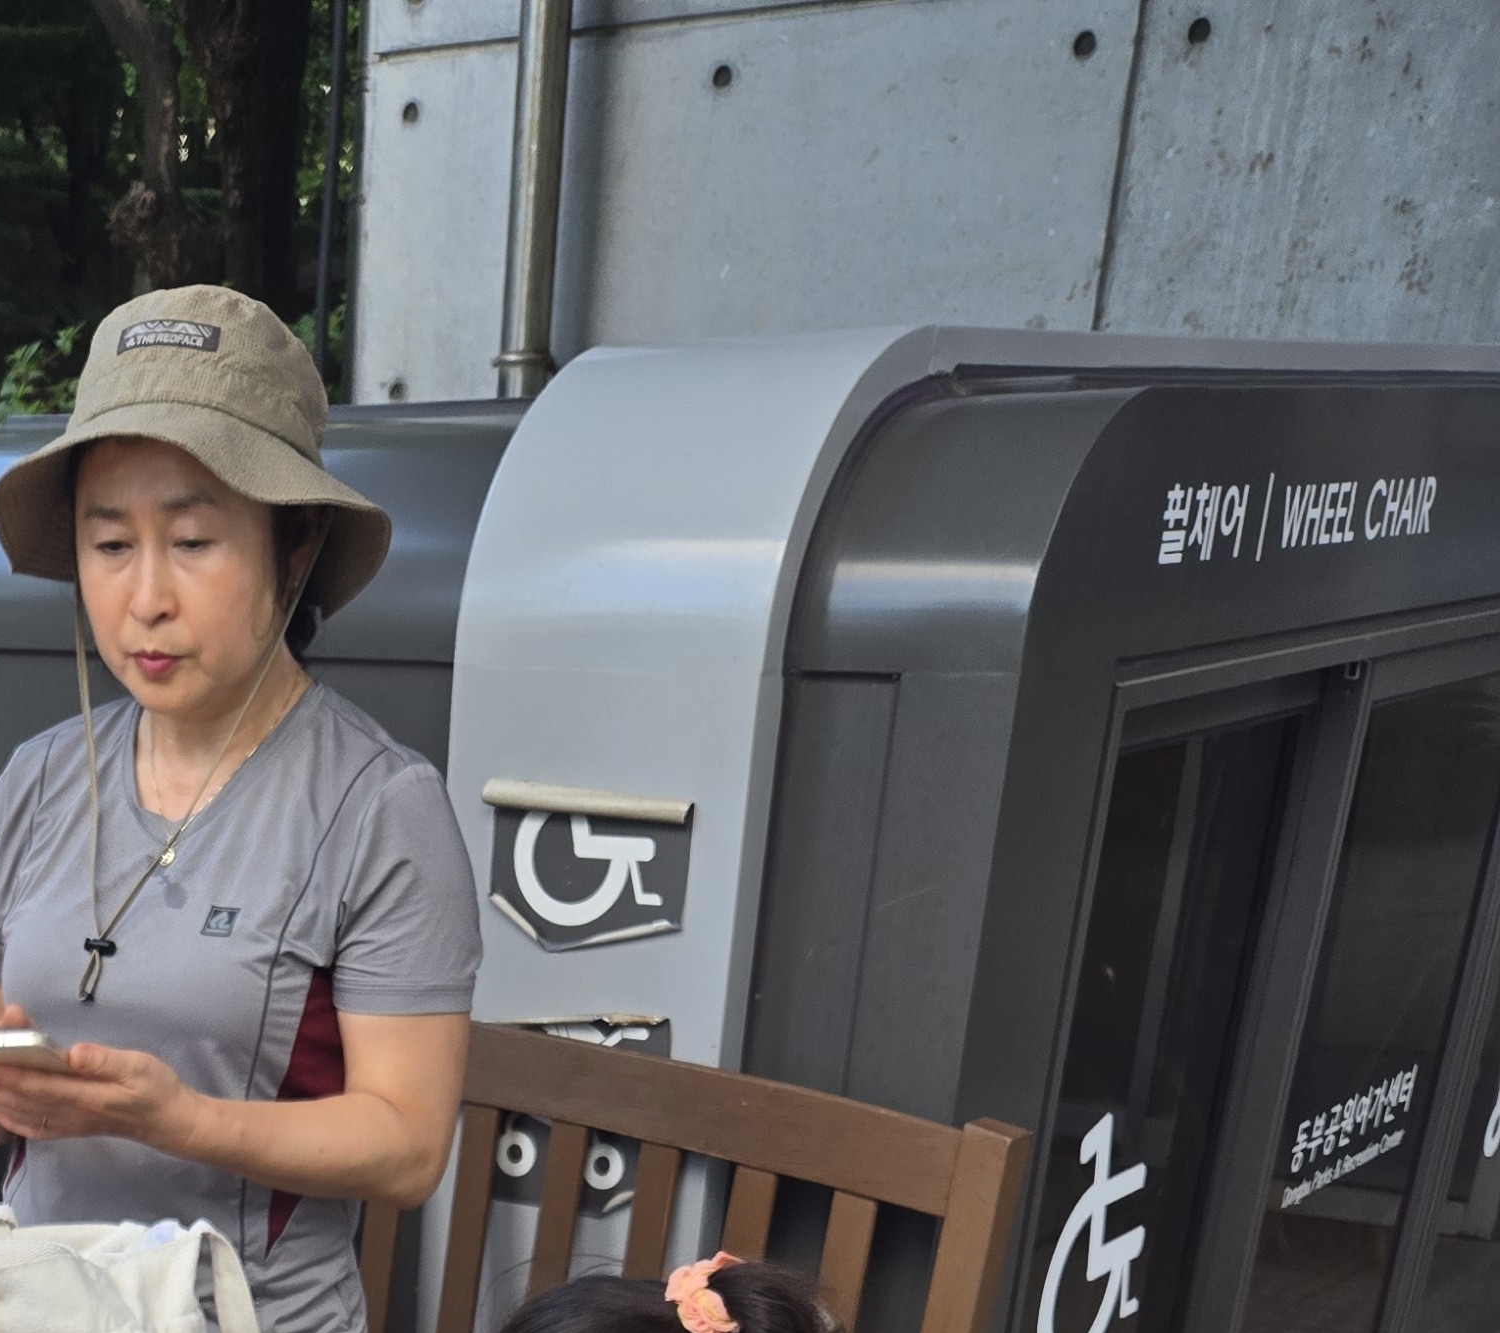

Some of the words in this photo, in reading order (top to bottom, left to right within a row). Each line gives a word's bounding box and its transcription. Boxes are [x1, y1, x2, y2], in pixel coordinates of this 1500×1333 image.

[1158, 482, 1250, 565] 휠체어
[1281, 481, 1358, 549] WHEEL
[1364, 476, 1437, 540] CHAIR
